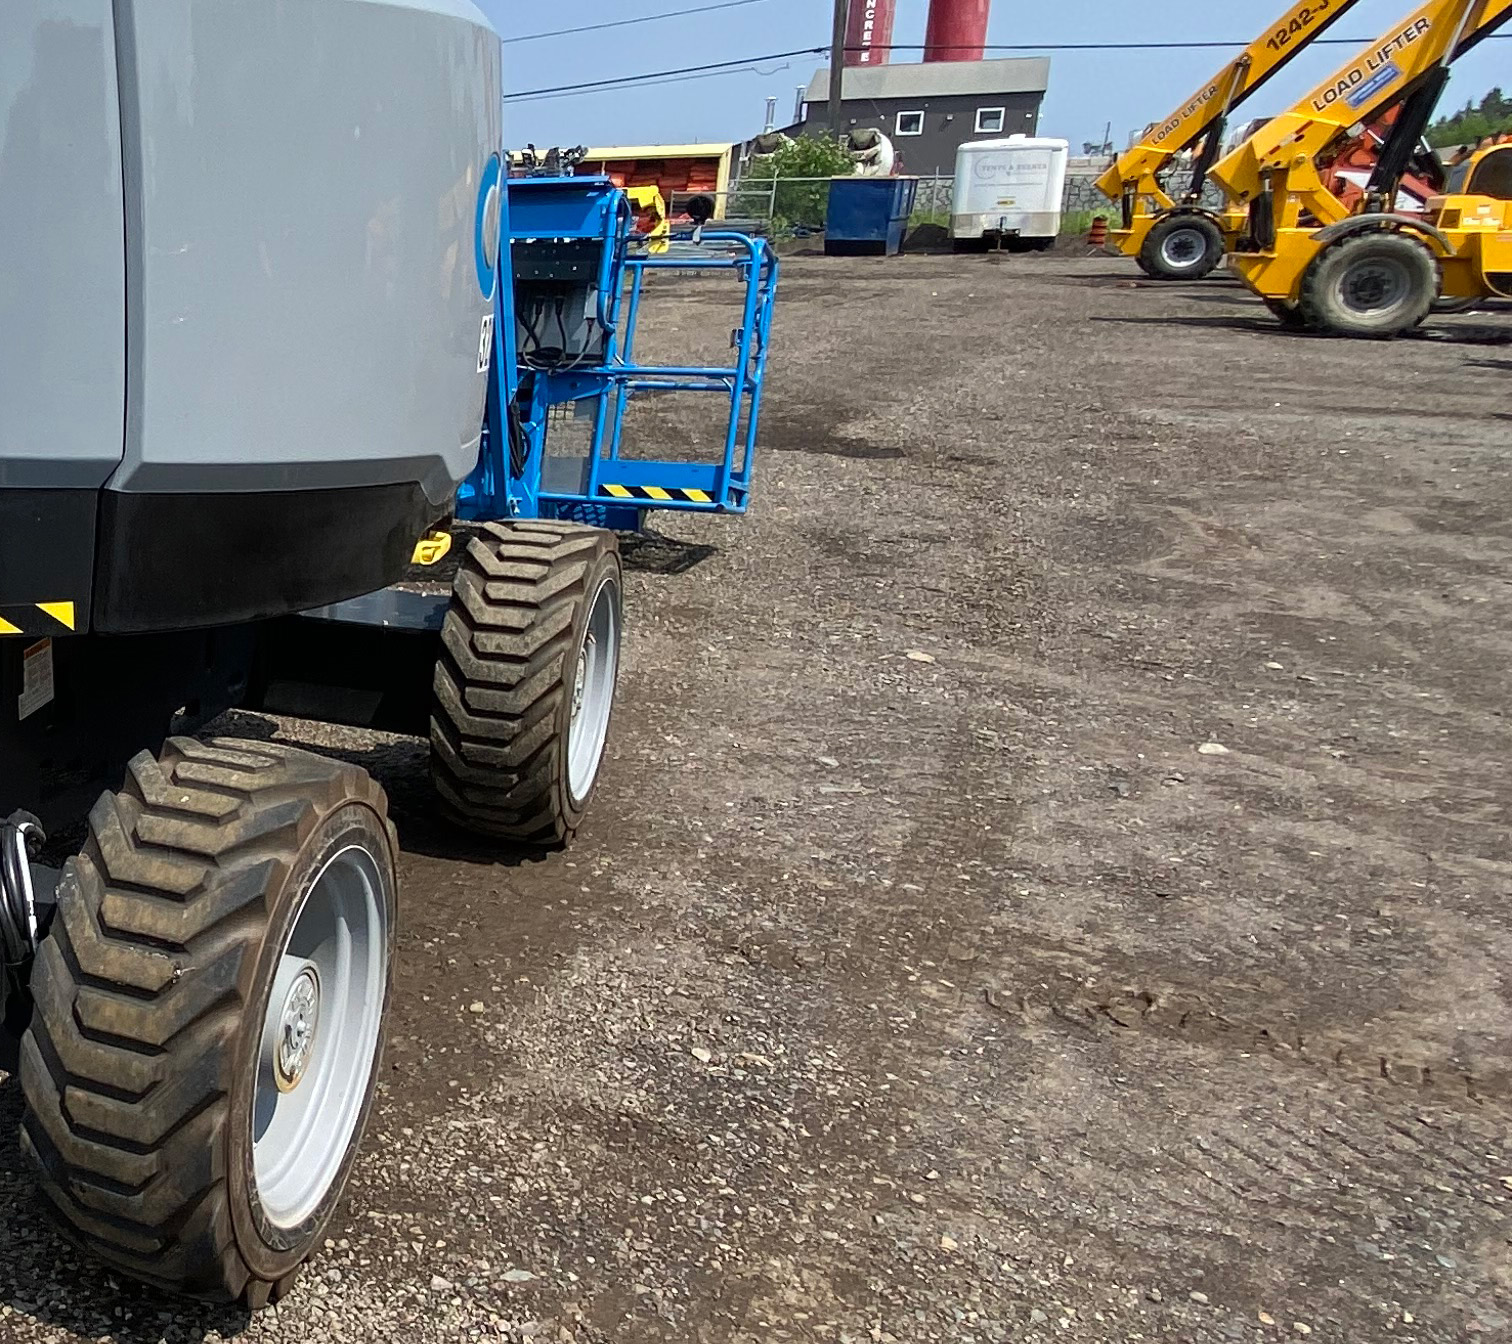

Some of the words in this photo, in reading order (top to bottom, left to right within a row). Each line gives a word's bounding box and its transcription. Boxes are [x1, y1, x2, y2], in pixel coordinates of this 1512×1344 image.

[1313, 68, 1363, 112] LOAD
[1366, 17, 1432, 70] LIFTER
[1152, 118, 1180, 146] LOAD
[1182, 84, 1218, 119] LIFTER
